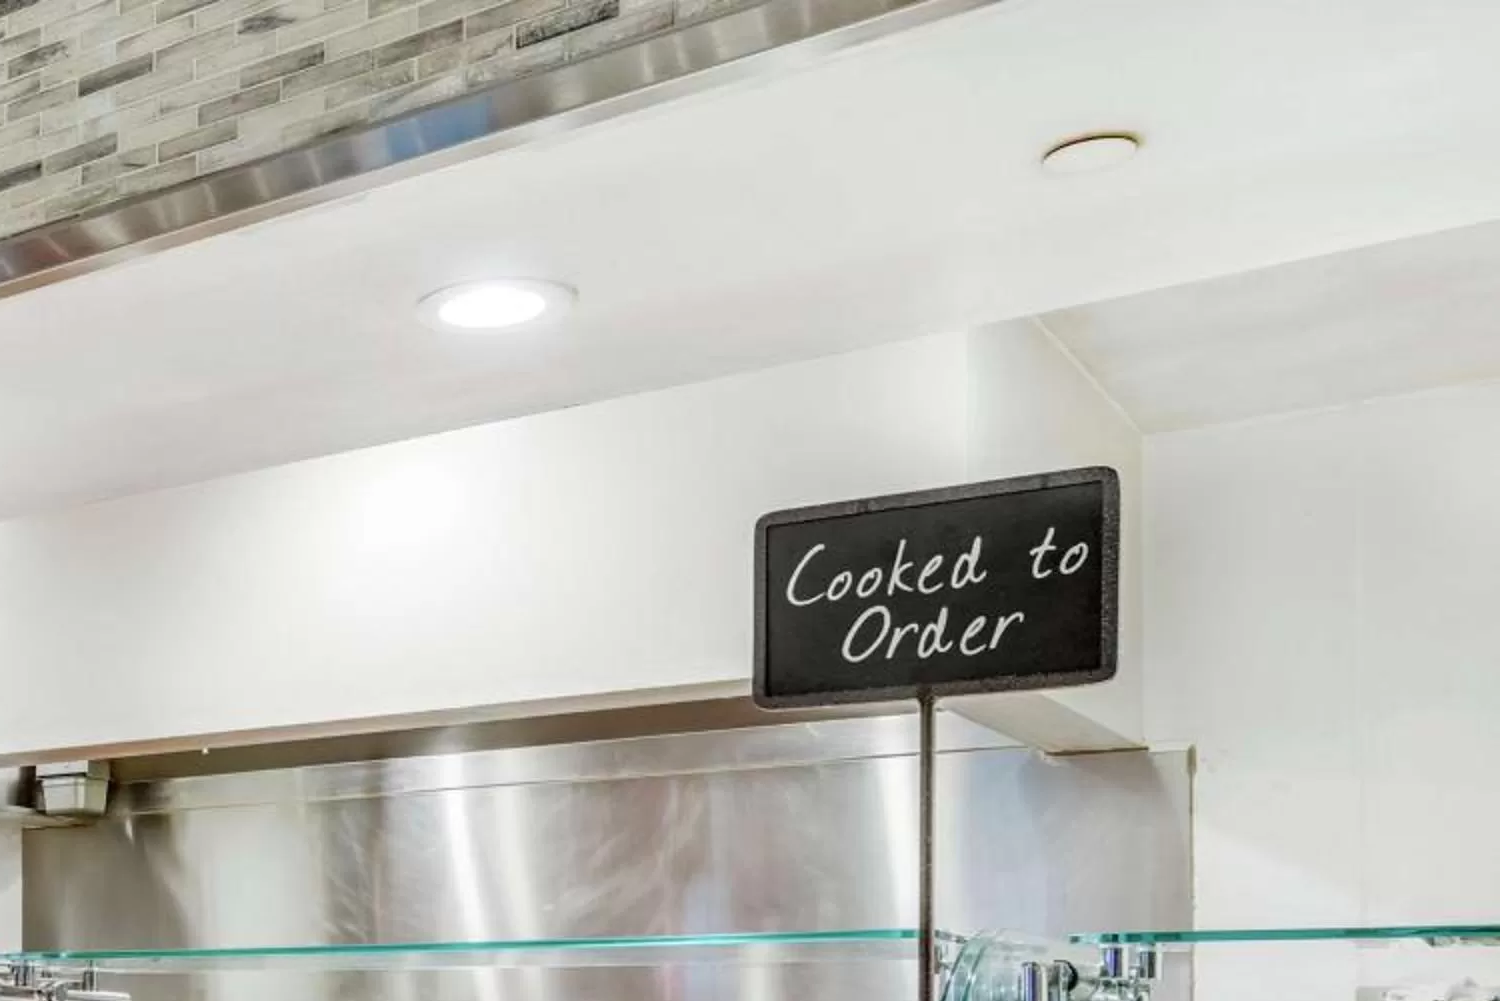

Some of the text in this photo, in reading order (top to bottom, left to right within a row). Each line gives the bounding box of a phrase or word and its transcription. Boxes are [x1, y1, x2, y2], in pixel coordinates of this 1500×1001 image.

[787, 527, 1089, 605] Cooked to
[842, 605, 1024, 662] Order
